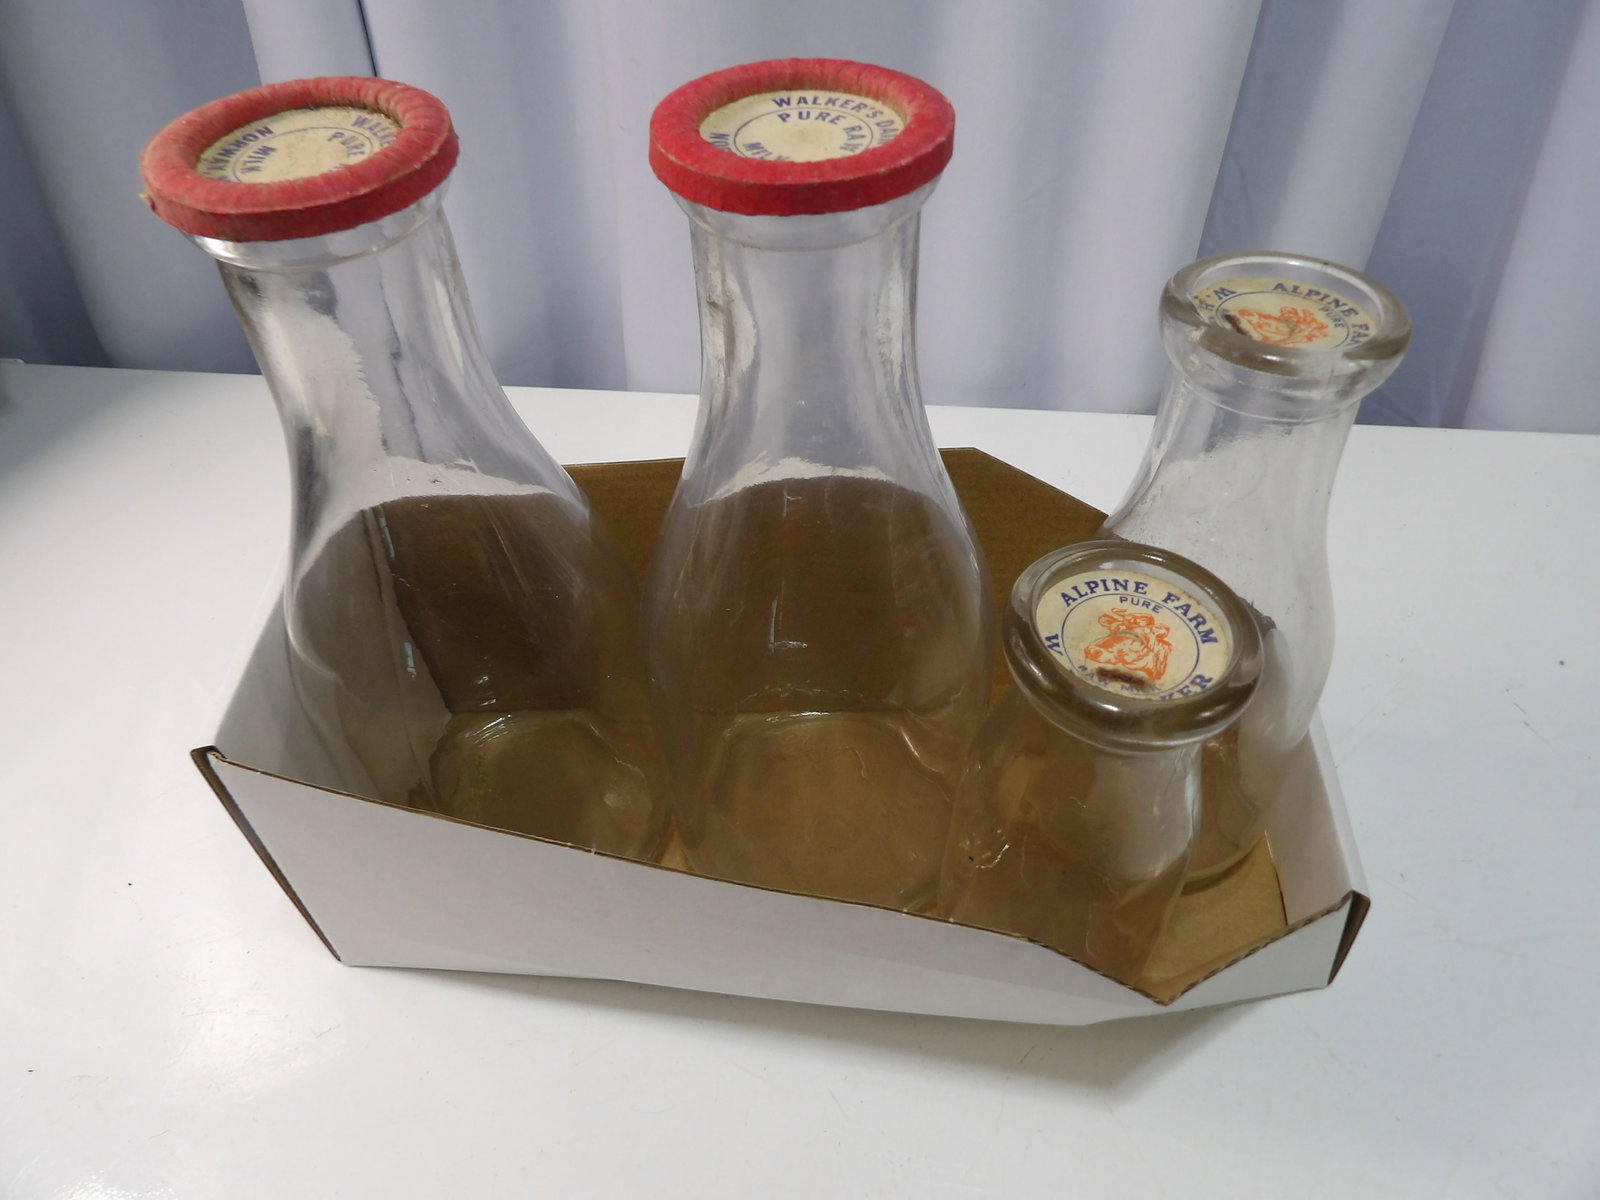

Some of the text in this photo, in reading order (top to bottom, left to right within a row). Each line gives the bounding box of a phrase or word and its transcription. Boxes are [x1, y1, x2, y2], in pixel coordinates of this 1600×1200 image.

[772, 96, 885, 119] WALKER'S
[777, 110, 848, 125] PURE
[327, 131, 366, 159] PURE
[240, 145, 276, 175] MILK
[1271, 281, 1360, 317] ALPINE
[1318, 305, 1346, 329] PURE
[1060, 578, 1219, 645] ALPINE FARM
[1119, 596, 1164, 615] PURE
